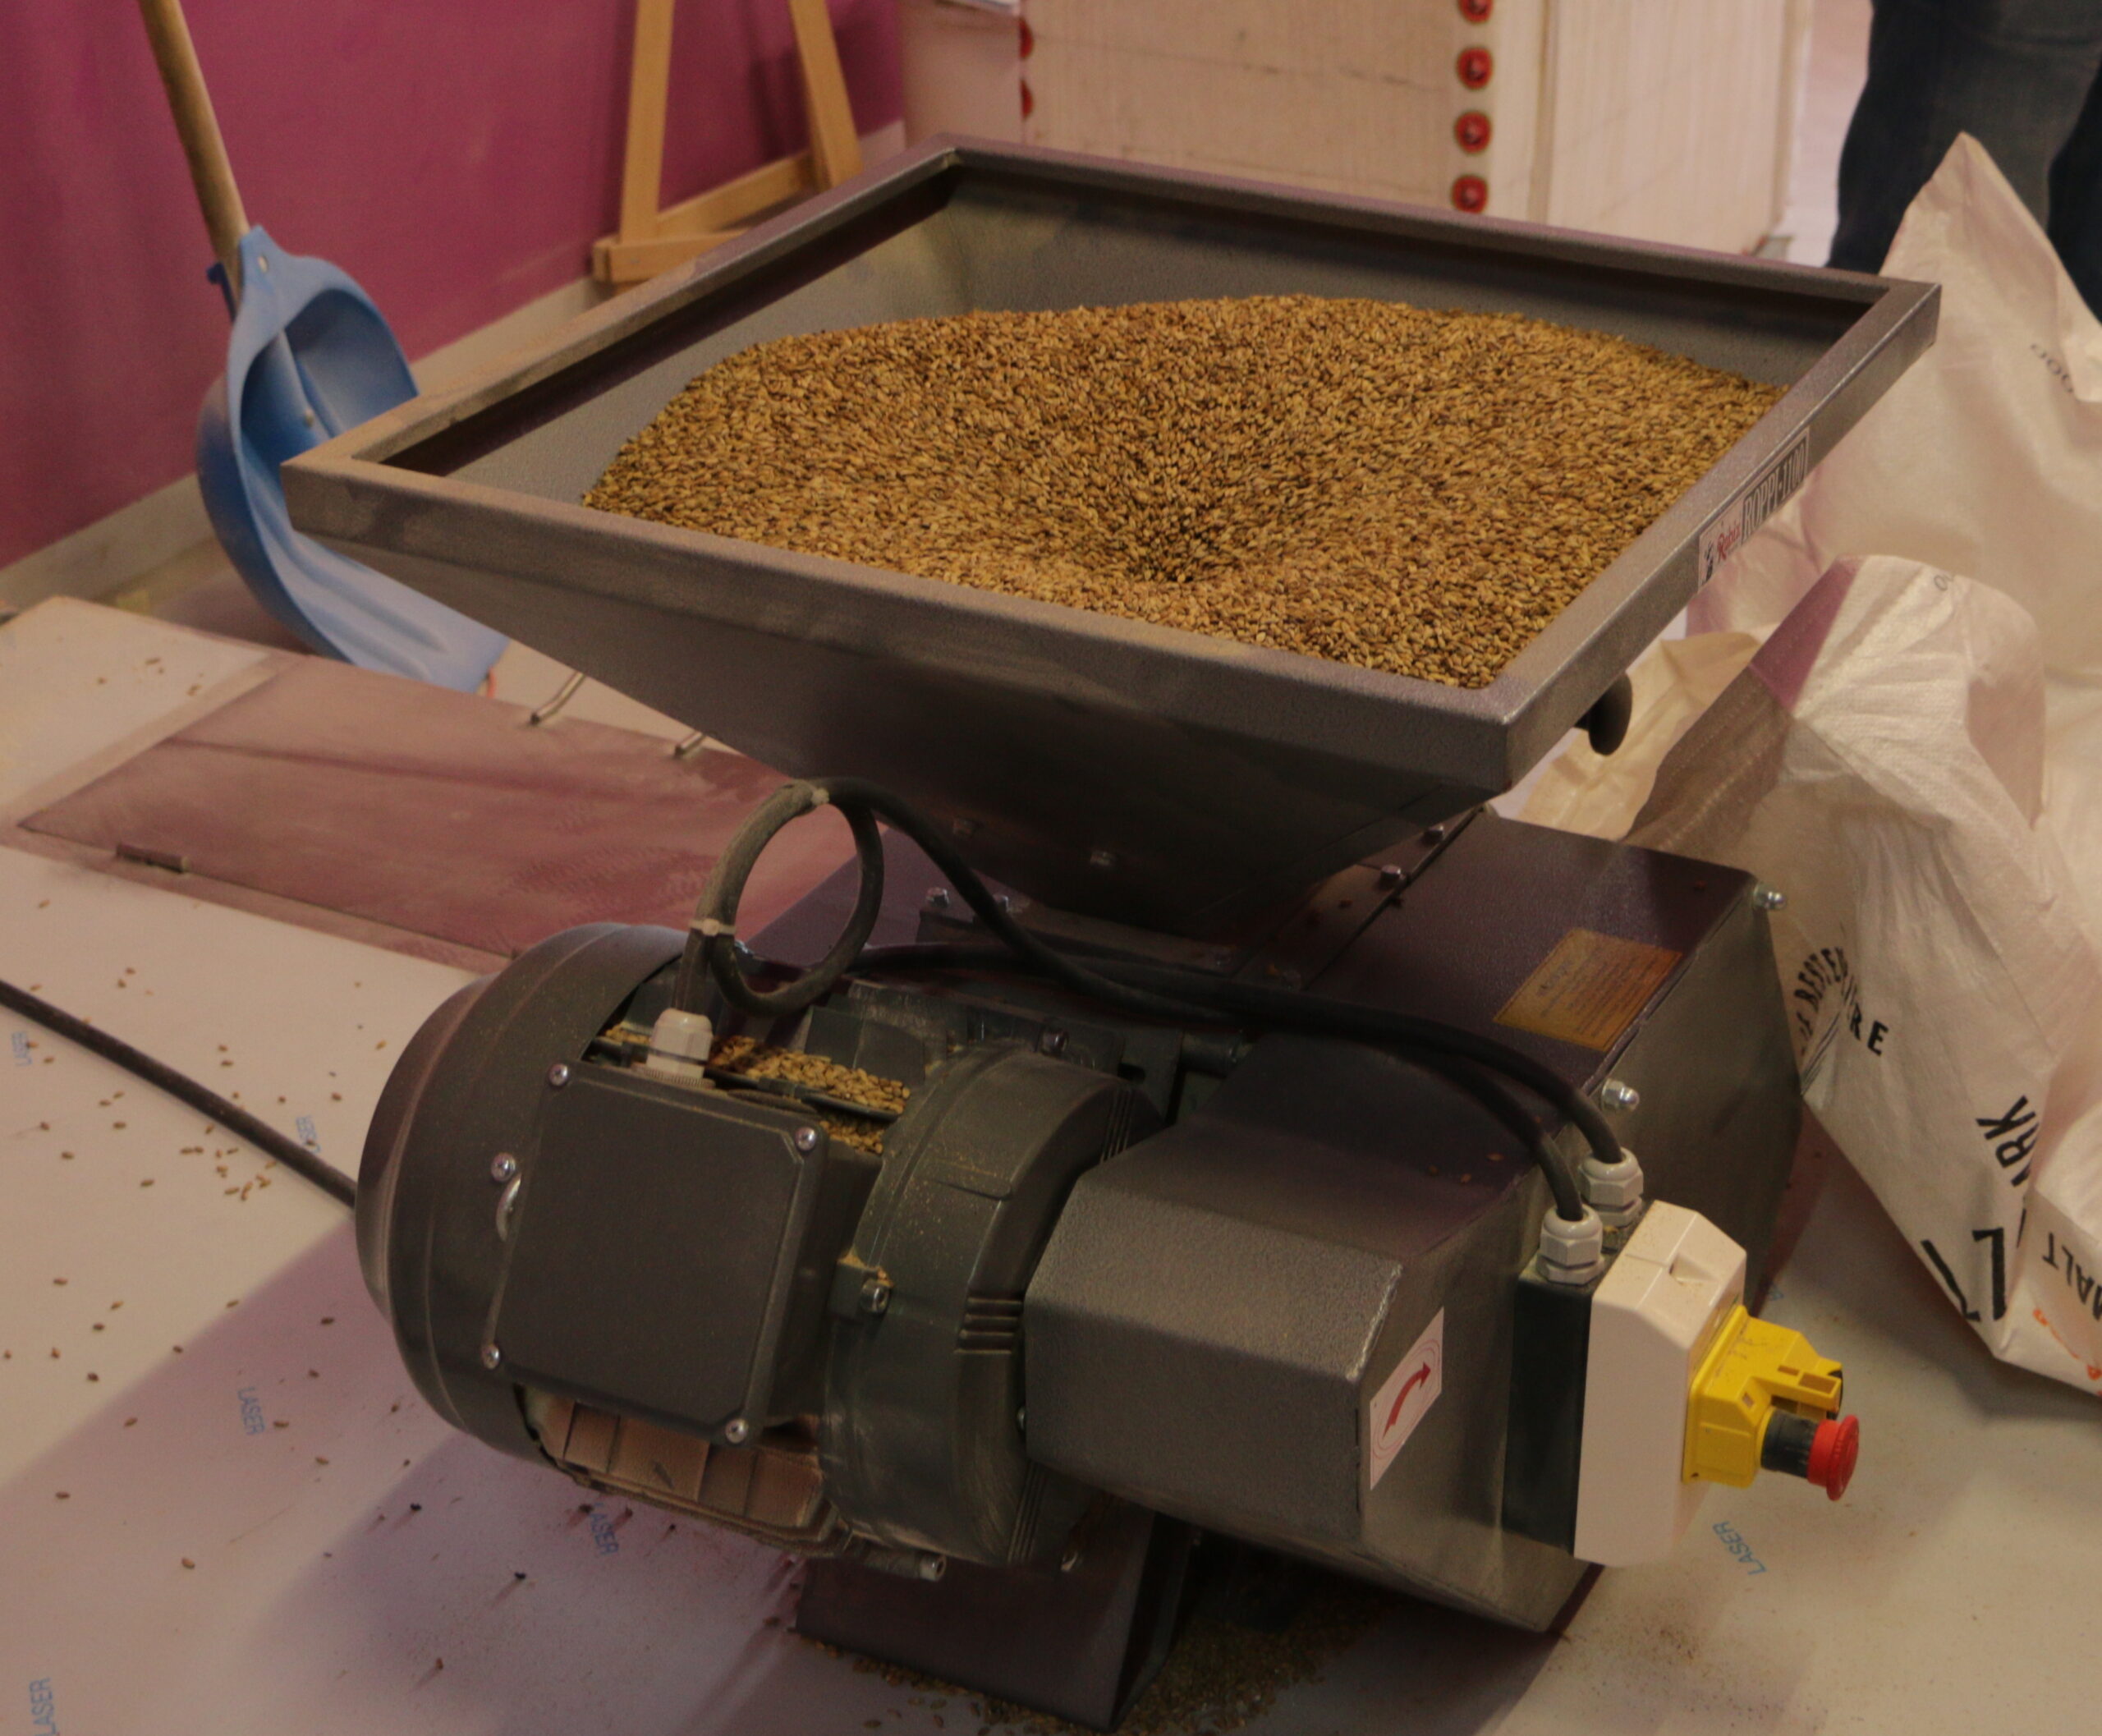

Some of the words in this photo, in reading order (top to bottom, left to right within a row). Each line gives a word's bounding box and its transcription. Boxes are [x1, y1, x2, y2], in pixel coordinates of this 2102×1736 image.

[237, 1386, 265, 1435] LASER
[1712, 1521, 1767, 1575] LASER
[29, 1677, 57, 1736] LASER
